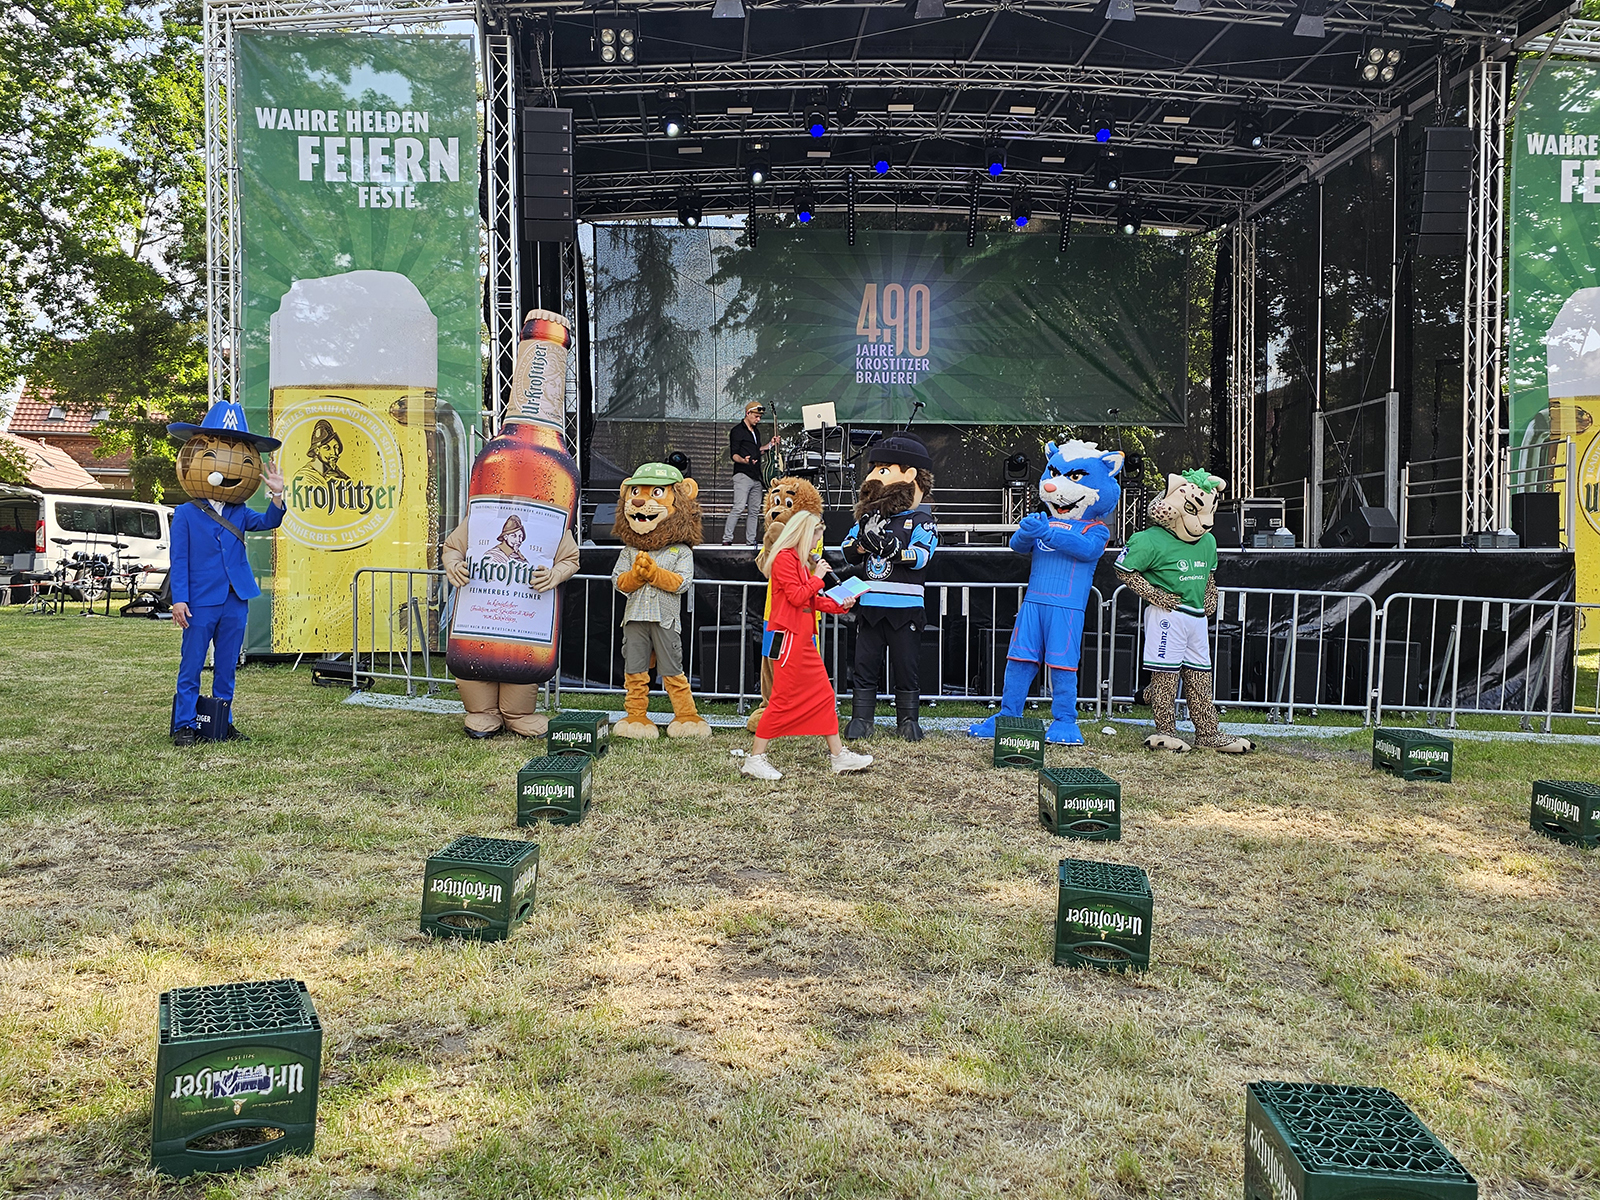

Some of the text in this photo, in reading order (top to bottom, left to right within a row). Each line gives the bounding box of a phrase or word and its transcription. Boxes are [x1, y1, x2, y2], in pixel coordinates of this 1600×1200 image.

[255, 107, 429, 133] WAHRE HELDEN
[1527, 133, 1599, 156] WAHRE
[298, 136, 460, 182] FEIERN
[358, 187, 416, 208] FESTE
[856, 344, 894, 357] JAHRE
[856, 357, 930, 371] KROSTITZER
[856, 371, 917, 385] BRAUEREI
[305, 404, 383, 437] BRAUHANDWERK
[380, 435, 393, 456] SEIT
[387, 458, 397, 480] 1534
[342, 513, 385, 543] PILSNER
[469, 587, 542, 601] FEINHERBES PILSNER
[1157, 631, 1169, 659] Allianz
